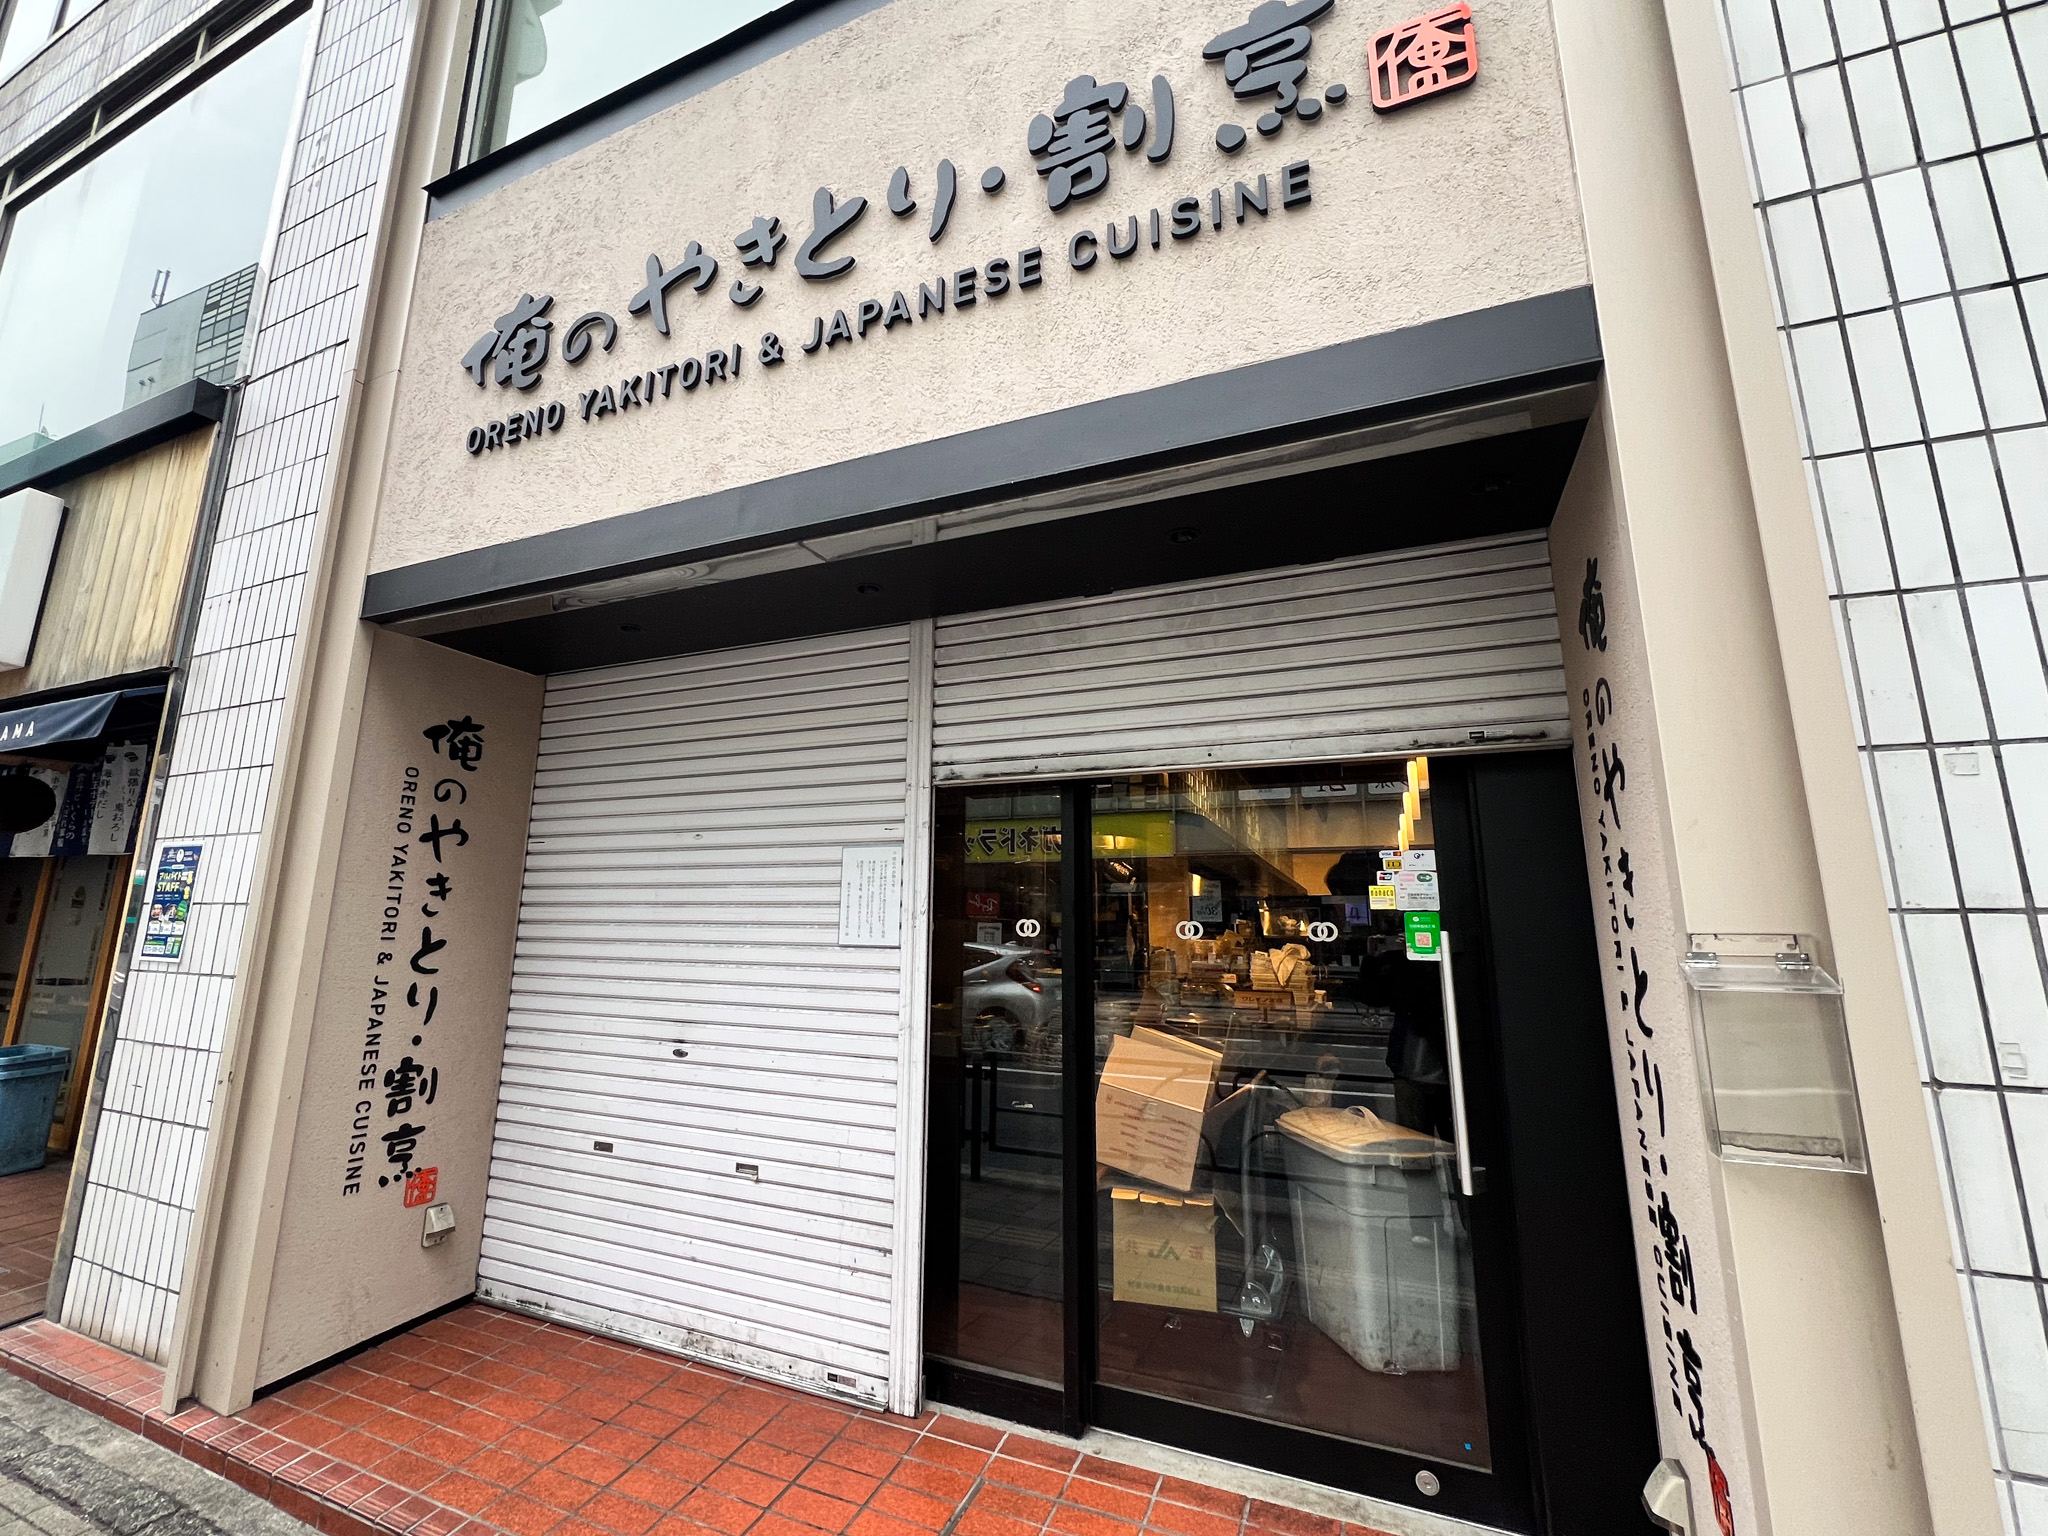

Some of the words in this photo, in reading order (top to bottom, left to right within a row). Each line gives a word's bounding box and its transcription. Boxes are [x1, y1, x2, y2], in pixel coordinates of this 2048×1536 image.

[465, 400, 565, 455] ORENO
[578, 343, 741, 421] YAKITORI
[757, 331, 785, 367] &
[802, 246, 1043, 355] JAPANESE
[1068, 159, 1313, 271] CUISINE
[395, 766, 420, 834] ORENO
[156, 882, 181, 892] STAFF
[380, 843, 409, 942] YAKITORI
[376, 951, 394, 966] &
[357, 974, 386, 1091] JAPANESE
[343, 1099, 373, 1197] CUISINE
